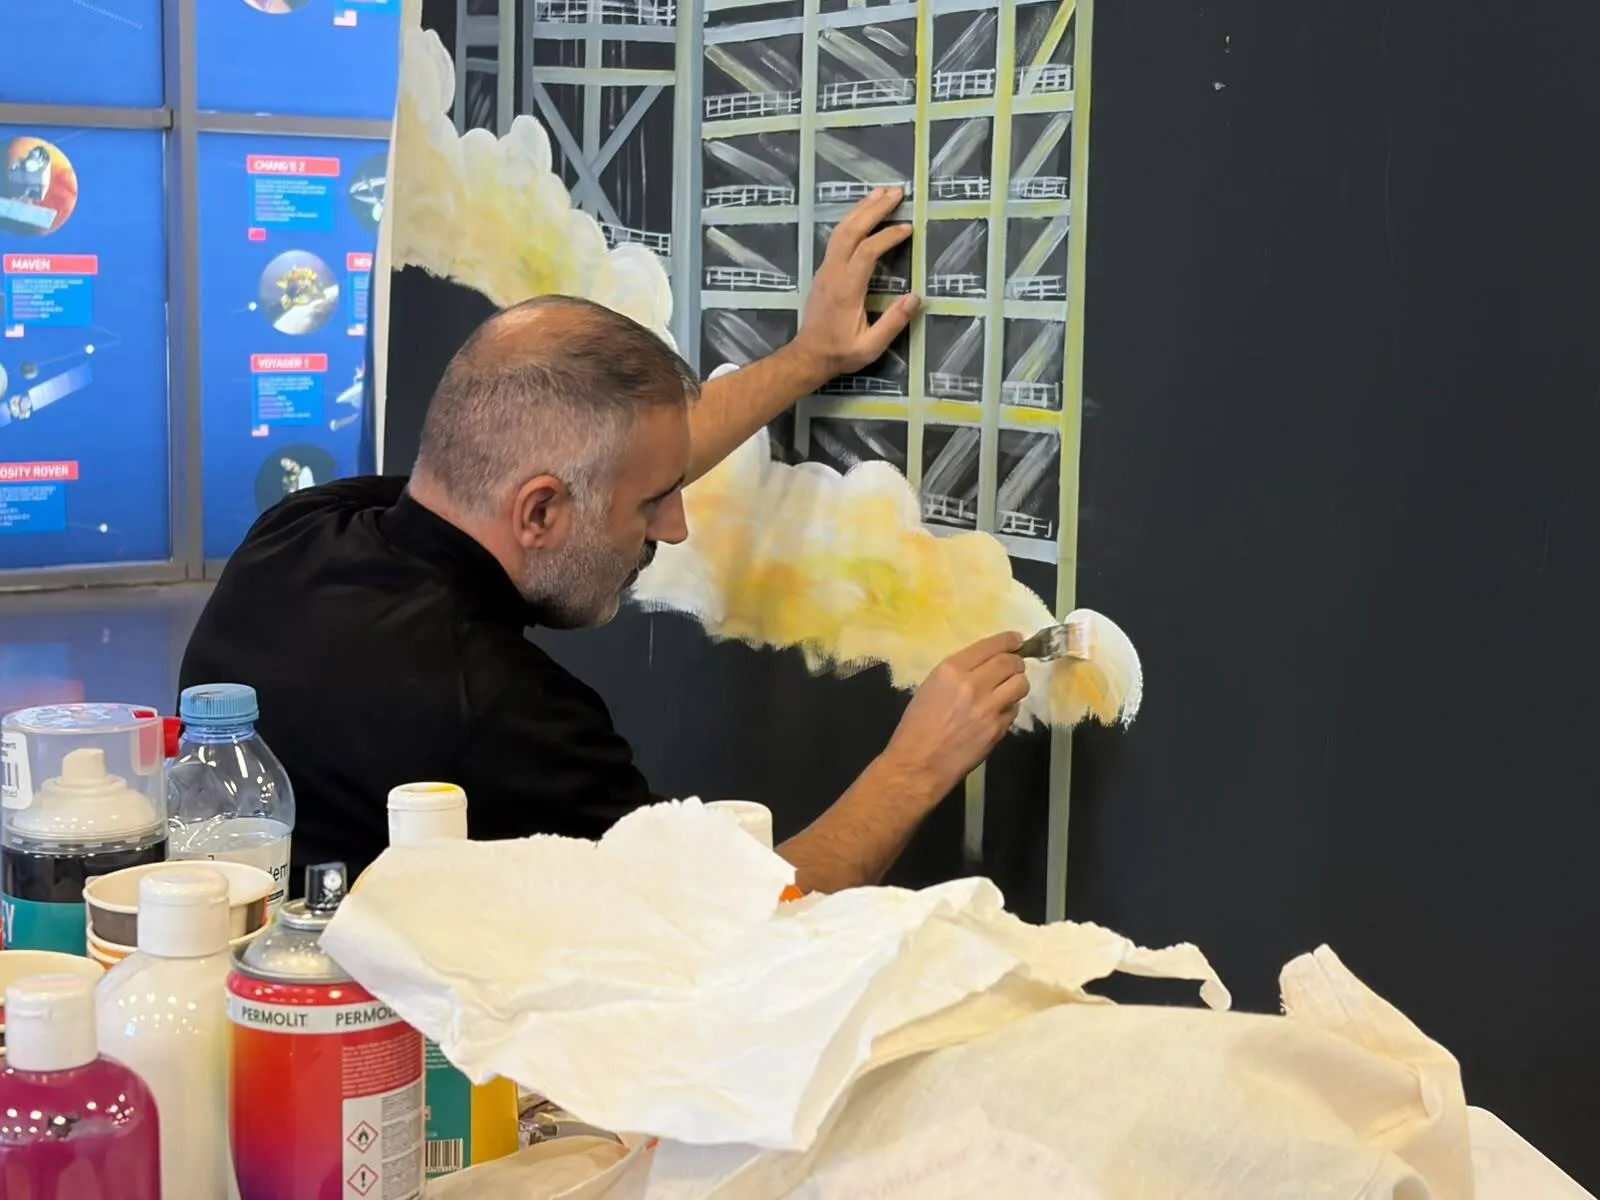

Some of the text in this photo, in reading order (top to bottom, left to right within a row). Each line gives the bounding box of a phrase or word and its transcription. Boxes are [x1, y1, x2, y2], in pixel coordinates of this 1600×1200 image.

[299, 161, 306, 173] 2
[11, 258, 51, 271] MAVEN
[258, 358, 302, 369] VOYAGER
[33, 464, 69, 477] ROVER
[335, 1003, 398, 1026] PERMOL
